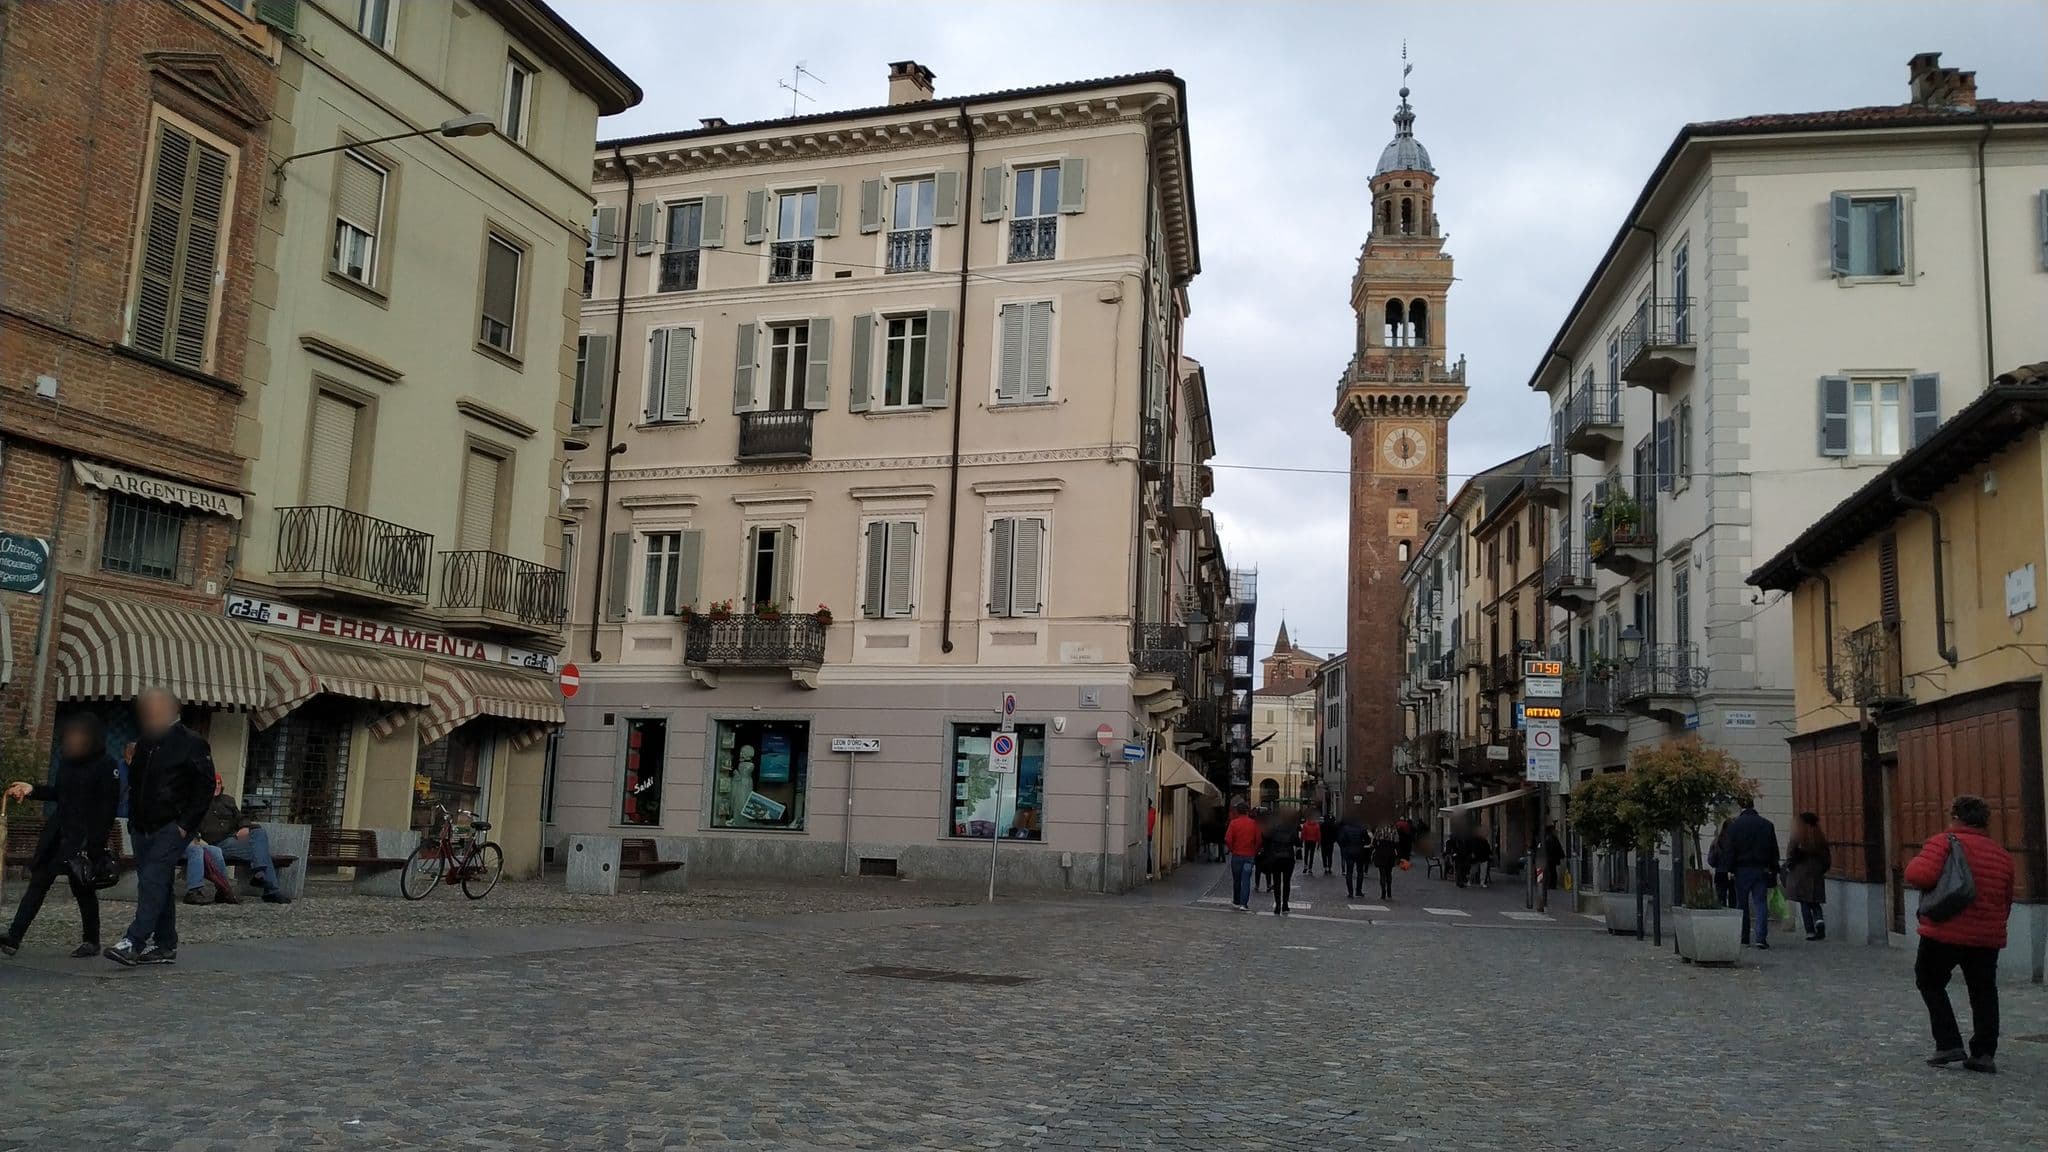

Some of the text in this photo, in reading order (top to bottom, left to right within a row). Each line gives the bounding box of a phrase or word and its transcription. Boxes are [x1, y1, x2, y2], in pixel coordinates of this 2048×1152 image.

[112, 474, 228, 511] ARGENTERIA
[297, 608, 487, 662] FERRAMENTA
[1526, 707, 1561, 718] ATTIVO
[633, 776, 654, 795] Saldi
